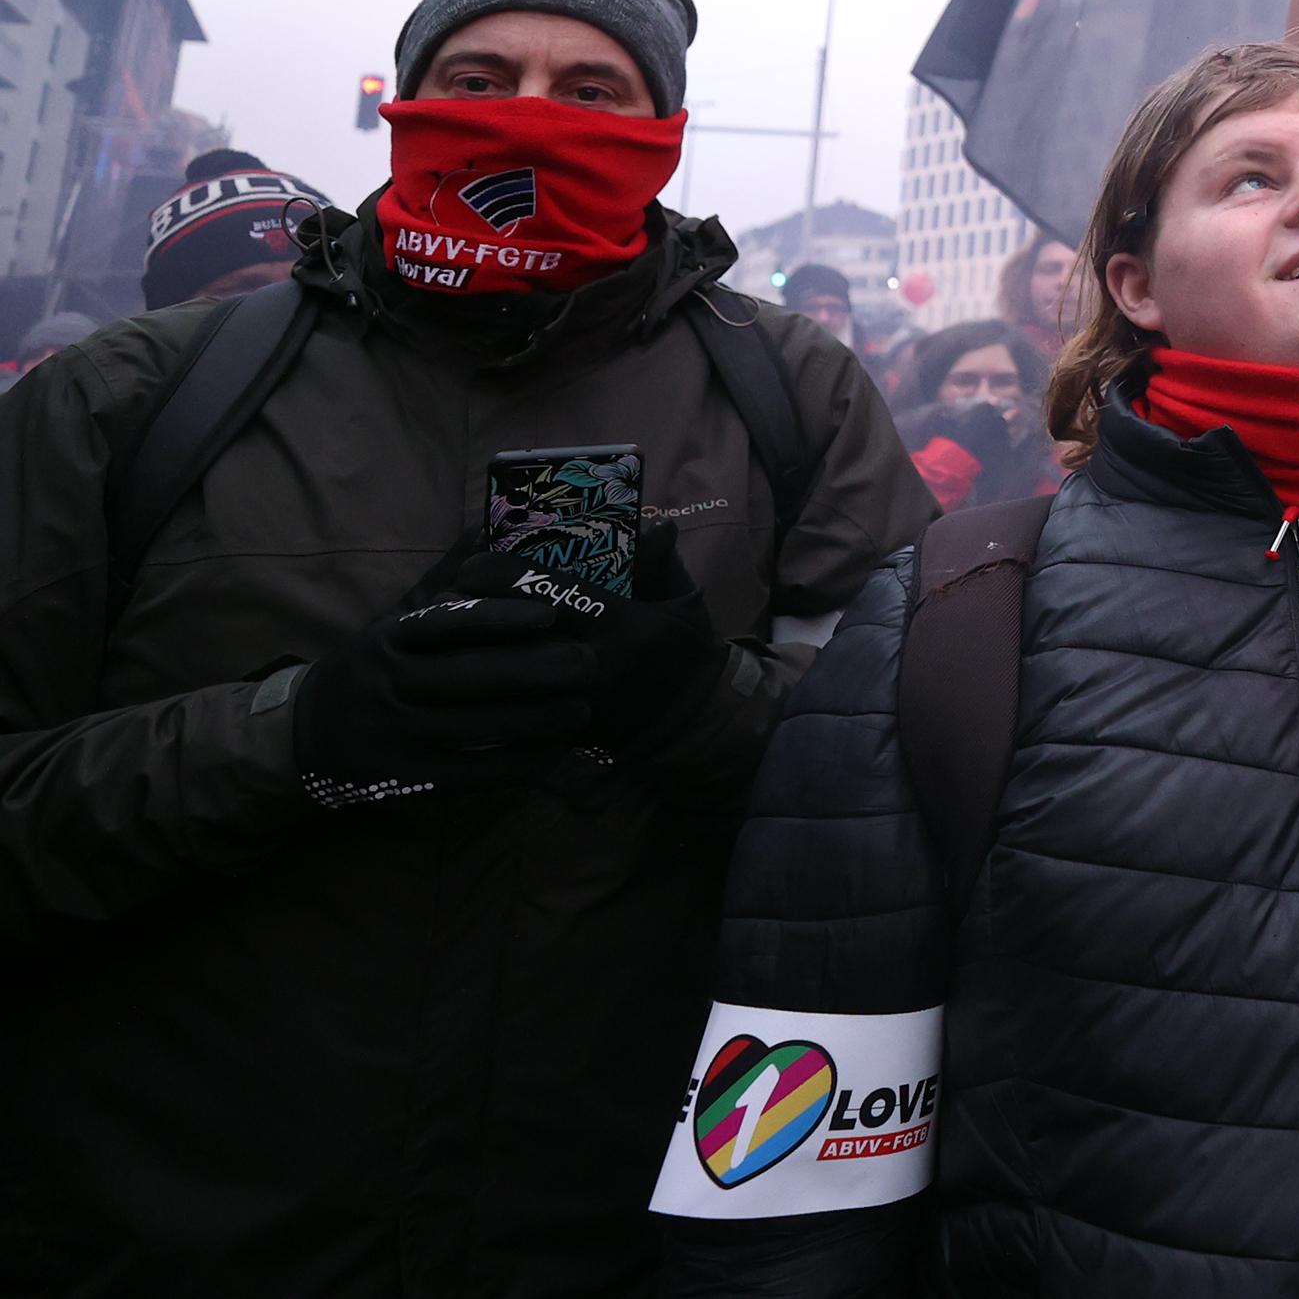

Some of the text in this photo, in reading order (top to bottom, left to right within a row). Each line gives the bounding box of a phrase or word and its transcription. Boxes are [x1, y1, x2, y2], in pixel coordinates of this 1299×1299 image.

[395, 228, 562, 272] ABVV-FGTB
[394, 254, 469, 288] Horval
[640, 498, 729, 519] Quechua
[511, 568, 606, 619] Kaytan
[829, 1073, 939, 1131] LOVE
[823, 1126, 929, 1158] ABVV-FGTB
